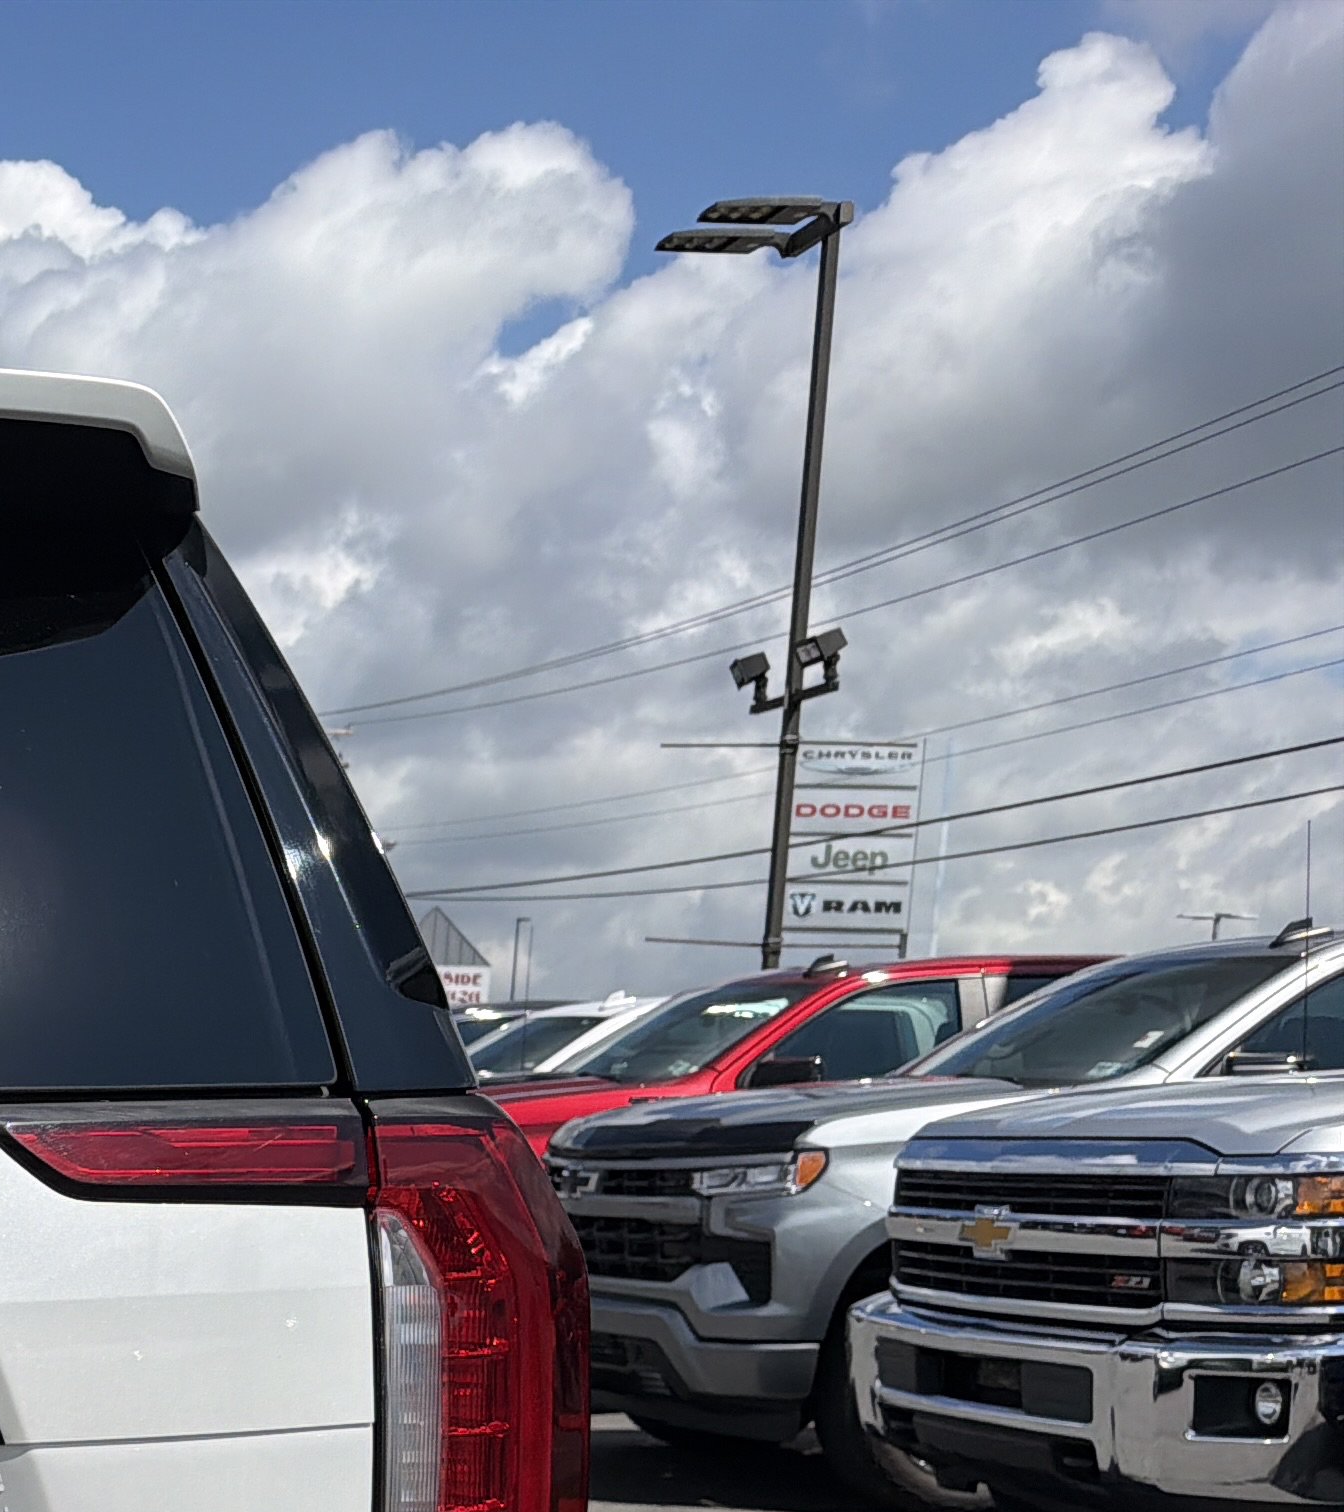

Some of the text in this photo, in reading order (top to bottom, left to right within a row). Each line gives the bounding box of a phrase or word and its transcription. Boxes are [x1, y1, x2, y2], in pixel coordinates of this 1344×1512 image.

[802, 749, 913, 760] CHRYSLER
[795, 803, 912, 819] DODGE
[810, 843, 889, 876] Jeep
[822, 899, 902, 914] RAM
